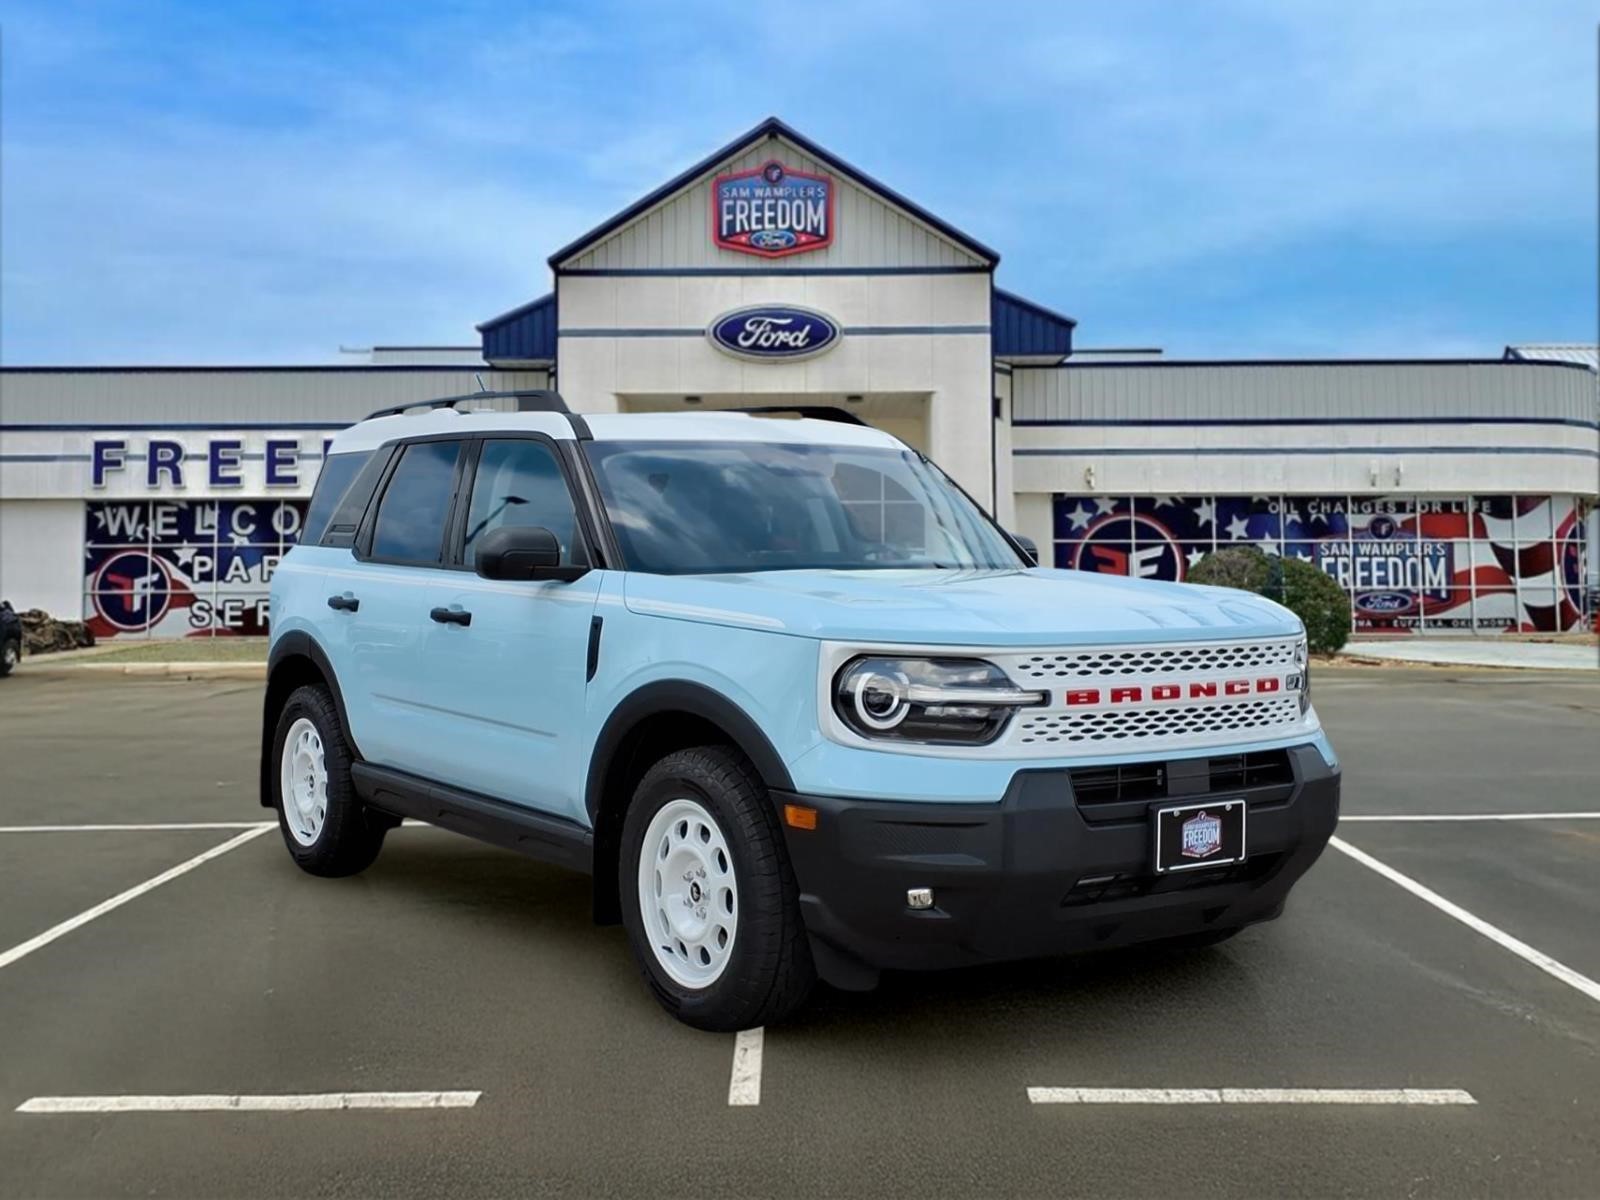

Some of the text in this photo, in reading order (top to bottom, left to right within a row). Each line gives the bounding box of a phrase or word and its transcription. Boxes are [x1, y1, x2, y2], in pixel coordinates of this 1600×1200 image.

[723, 187, 750, 198] SAM
[722, 199, 826, 236] FREEDOM
[737, 316, 811, 348] Ford
[93, 440, 334, 485] FREE
[1268, 500, 1491, 514] OIL CHANGES FOR LIFE
[1320, 557, 1447, 599] FREEDOM
[1366, 595, 1400, 608] Ford
[1065, 676, 1280, 706] BRONCO
[1183, 828, 1220, 849] FREEDOM
